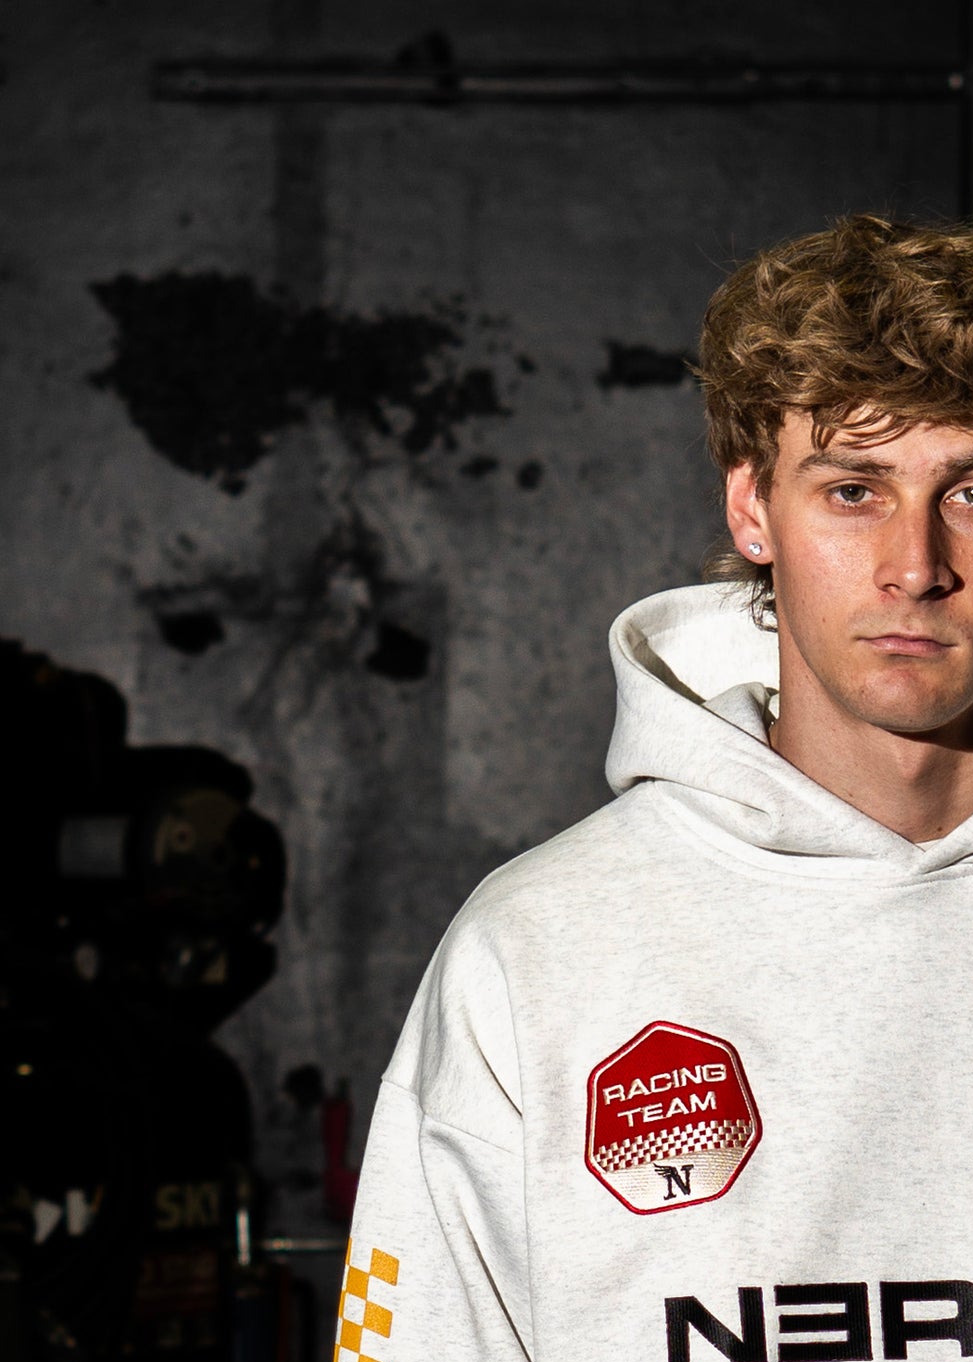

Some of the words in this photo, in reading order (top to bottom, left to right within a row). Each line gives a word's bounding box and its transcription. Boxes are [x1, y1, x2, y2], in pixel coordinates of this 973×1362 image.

[603, 1063, 727, 1105] RACING
[617, 1091, 717, 1127] TEAM
[654, 1162, 694, 1200] N
